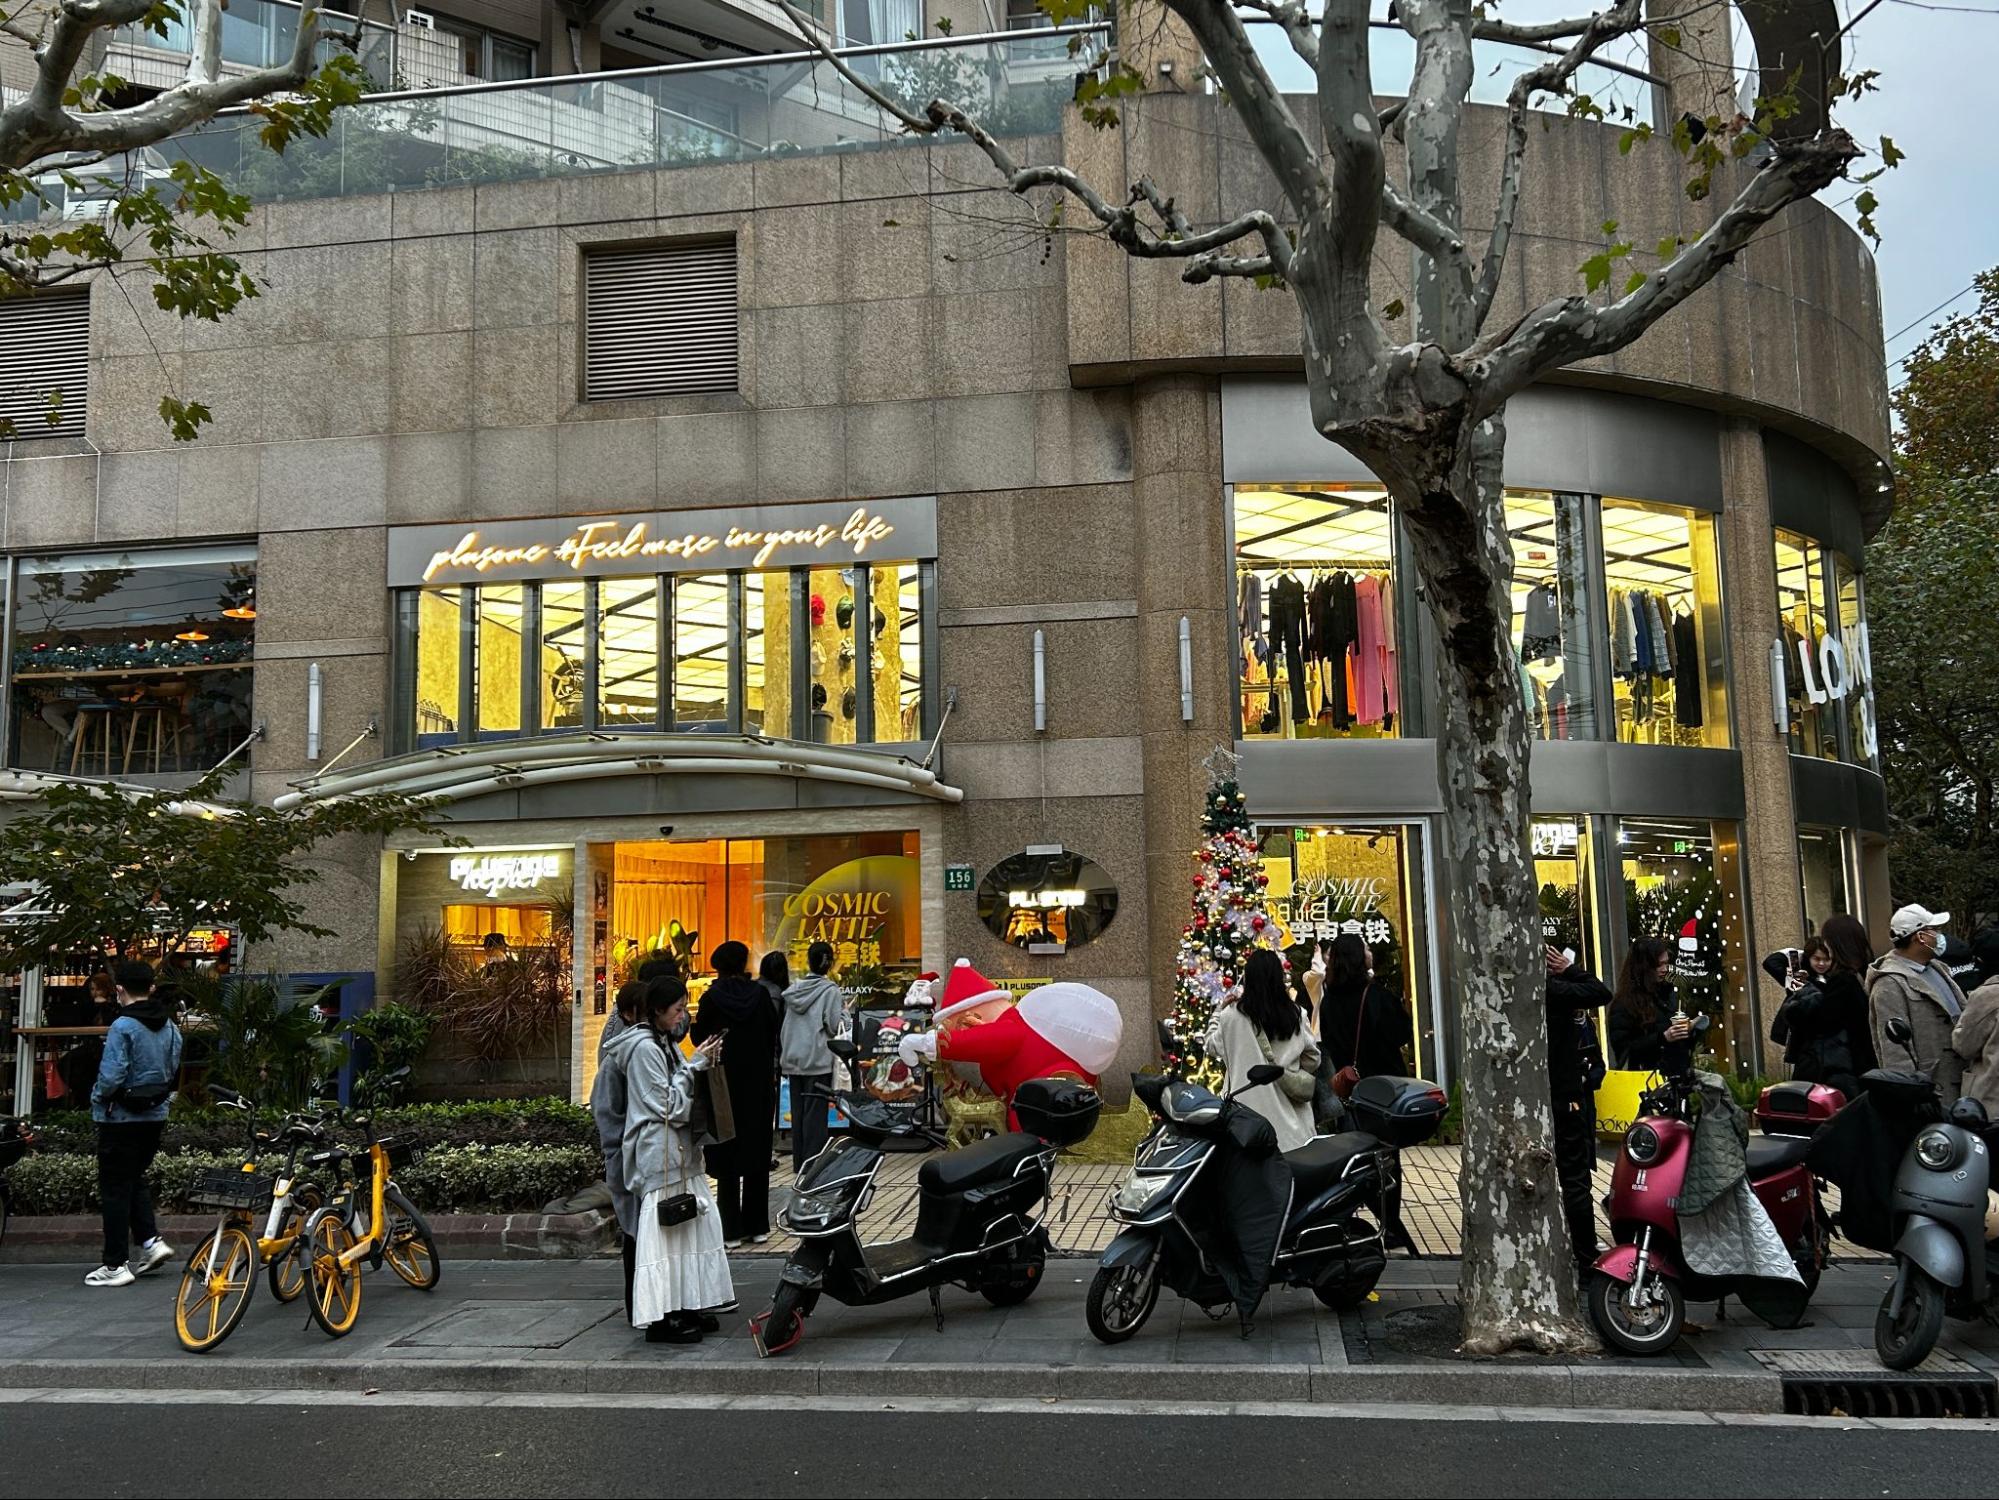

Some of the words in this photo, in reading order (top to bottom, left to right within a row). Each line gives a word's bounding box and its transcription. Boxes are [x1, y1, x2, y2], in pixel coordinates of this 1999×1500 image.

[640, 534, 719, 558] more
[725, 526, 763, 547] in
[753, 524, 838, 567] your
[841, 507, 894, 554] life
[949, 871, 970, 883] 156
[1291, 877, 1386, 896] COSMIC
[783, 892, 891, 917] COSMIC
[1301, 894, 1382, 914] LATTE
[797, 916, 877, 940] LATTE
